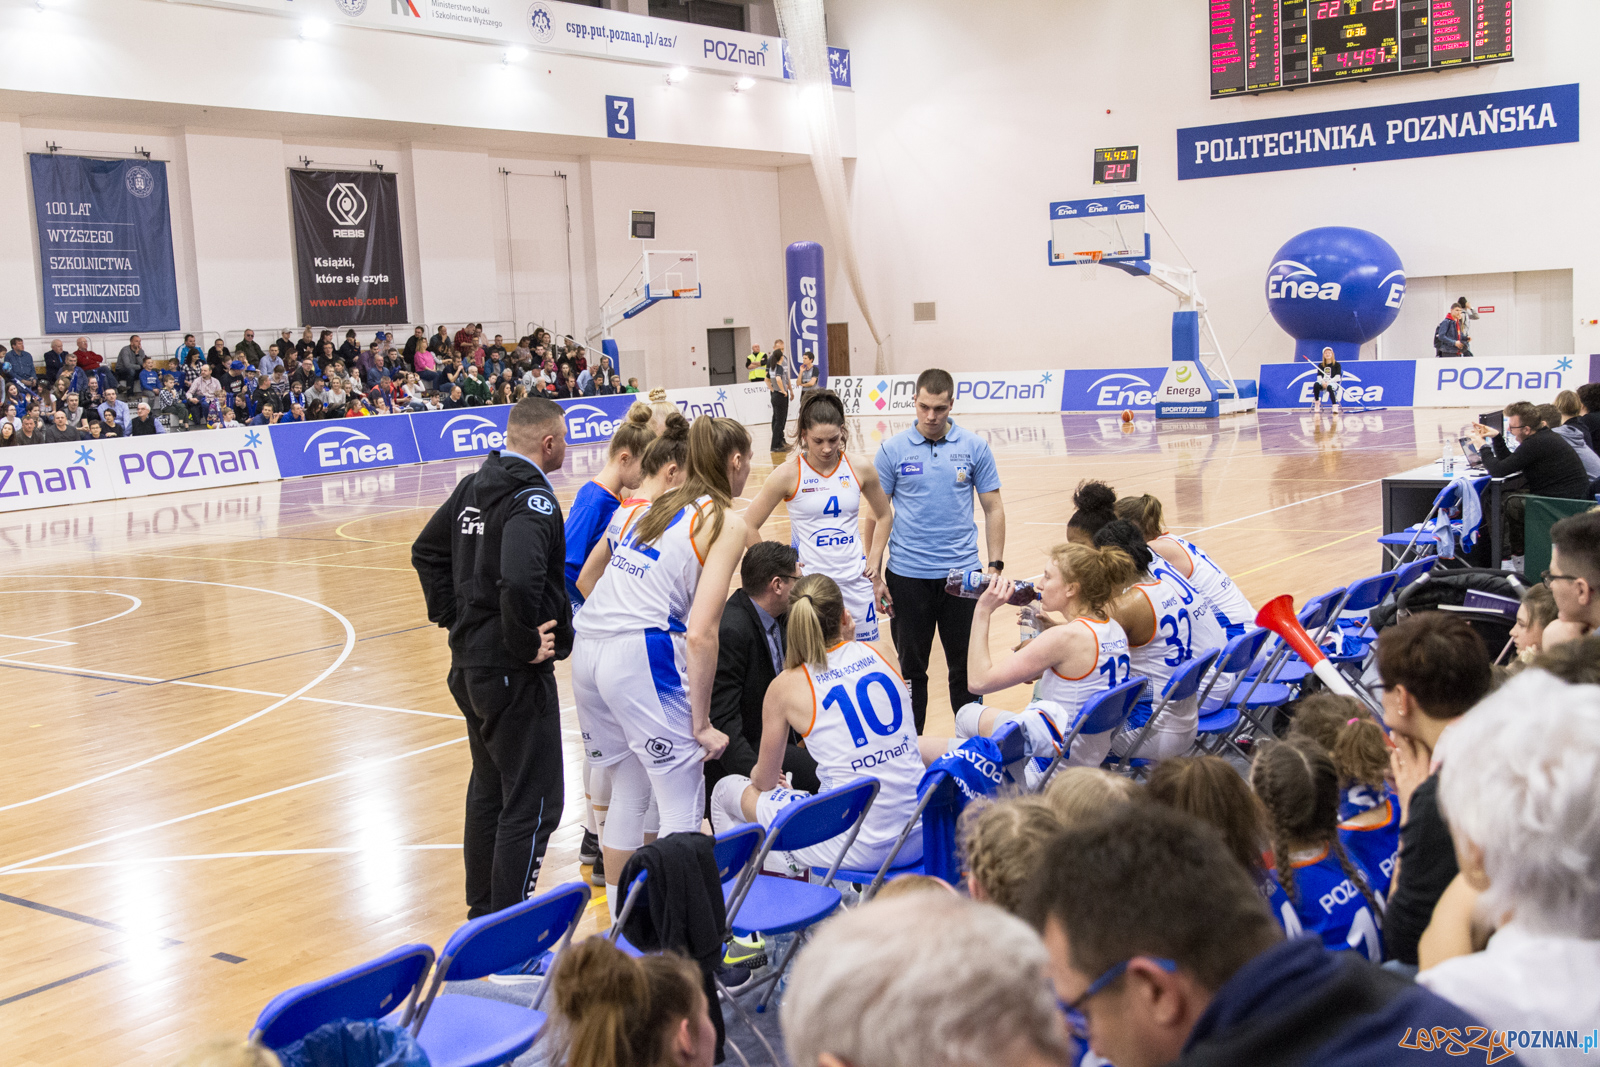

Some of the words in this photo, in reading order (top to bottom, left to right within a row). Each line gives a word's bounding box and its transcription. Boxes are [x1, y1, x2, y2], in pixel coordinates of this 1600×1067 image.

[431, 0, 472, 13] Ministerstwo
[472, 6, 490, 15] Nauki
[436, 11, 472, 23] Szkolnictwa
[473, 15, 503, 28] Wyższego
[566, 20, 677, 48] cspp.put.poznan.pl/azs/
[613, 100, 630, 134] 3
[1195, 122, 1377, 165] POLITECHNIKA
[1386, 102, 1557, 145] POZNAŃSKA
[1105, 164, 1127, 180] 24
[46, 202, 67, 215] 100
[69, 202, 92, 216] LAT
[47, 227, 114, 243] WYŻSZEGO
[332, 229, 365, 238] REBIS
[50, 256, 133, 271] SZKOLNICTWA
[314, 257, 355, 269] Książki,
[315, 273, 343, 283] które
[345, 273, 360, 285] się
[362, 273, 389, 285] czyta
[52, 284, 141, 297] TECHNICZNEGO
[1268, 275, 1342, 301] Enea
[309, 296, 398, 307] www.rebis.com.pl
[55, 311, 68, 324] W
[72, 310, 129, 324] POZNANIU
[1437, 367, 1562, 391] POZnan
[956, 380, 1044, 400] POZnan
[1166, 386, 1201, 397] Energa
[318, 441, 394, 468] Enea
[119, 447, 260, 485] POZnan
[823, 496, 842, 518] 4
[816, 534, 854, 547] Enea
[866, 602, 876, 624] 4
[822, 671, 903, 749] 10
[850, 741, 910, 772] POZnan
